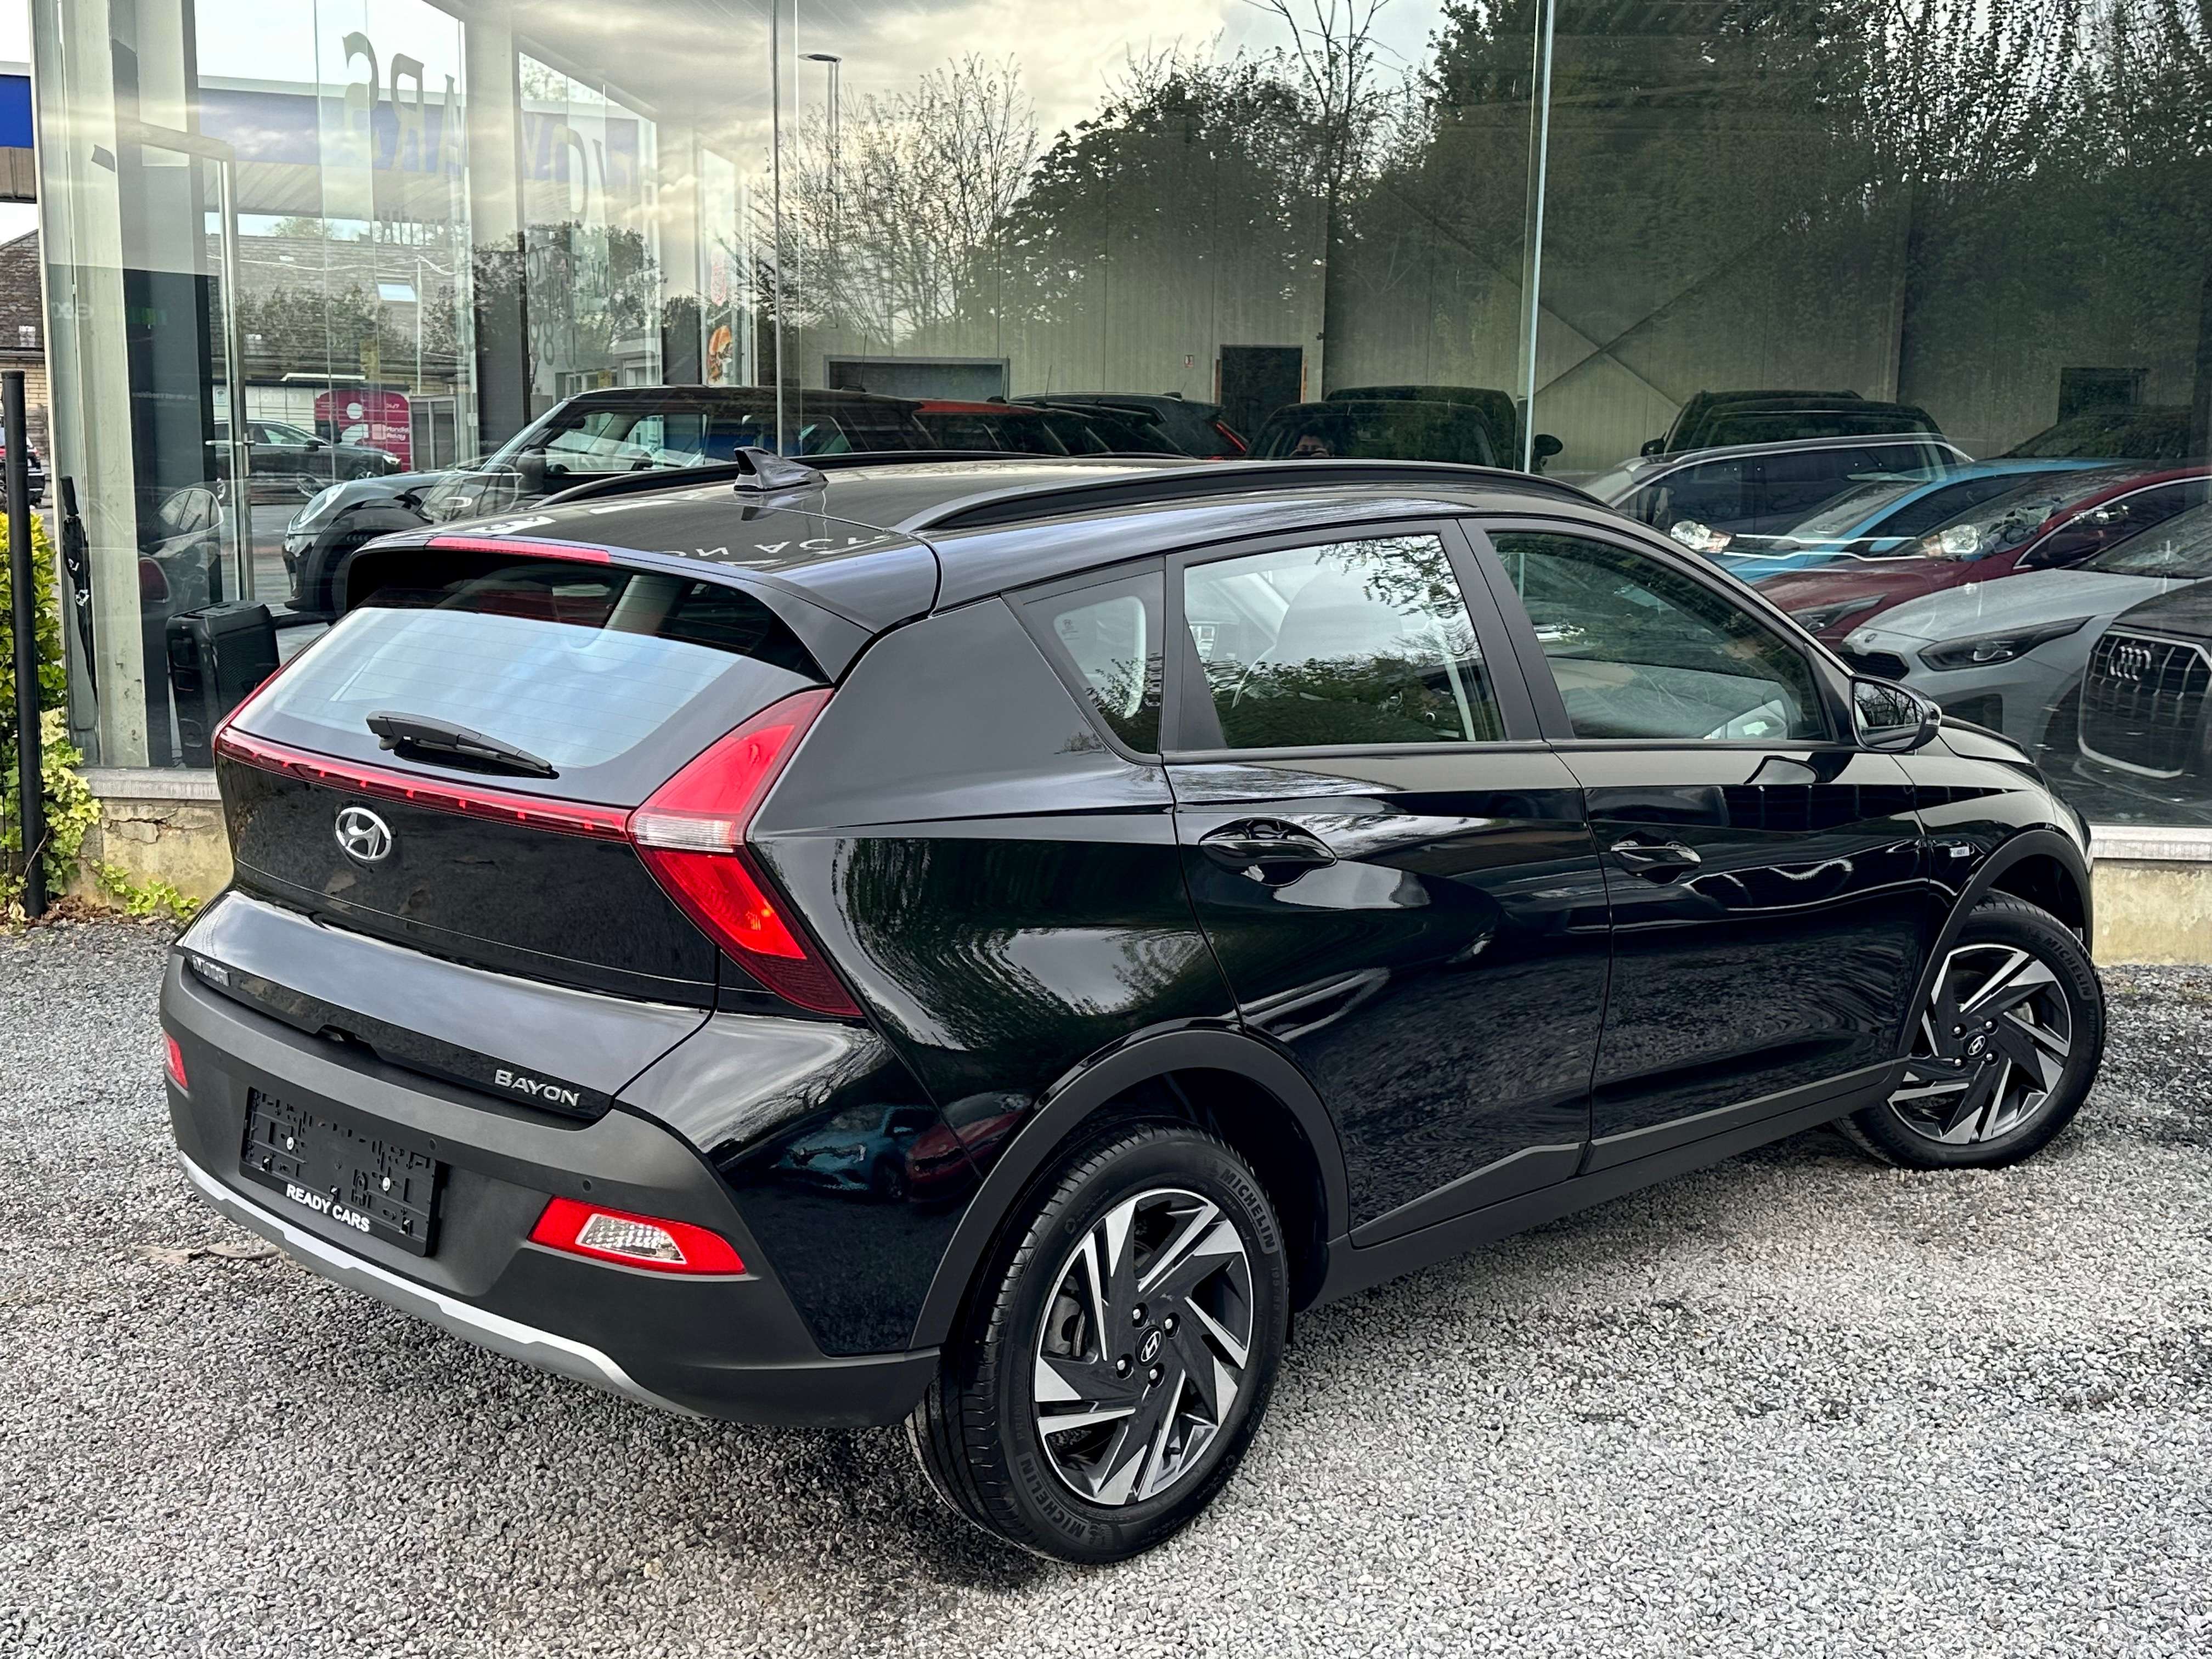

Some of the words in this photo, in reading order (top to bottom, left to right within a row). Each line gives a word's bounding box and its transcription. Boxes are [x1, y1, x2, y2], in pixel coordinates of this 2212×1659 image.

[2042, 936, 2093, 997] MICHELIN
[495, 1069, 580, 1107] BAYON
[286, 1184, 331, 1214] READY
[332, 1205, 370, 1232] CARS
[1220, 1167, 1276, 1249] MICHELIN
[1019, 1456, 1086, 1538] MICHELIN
